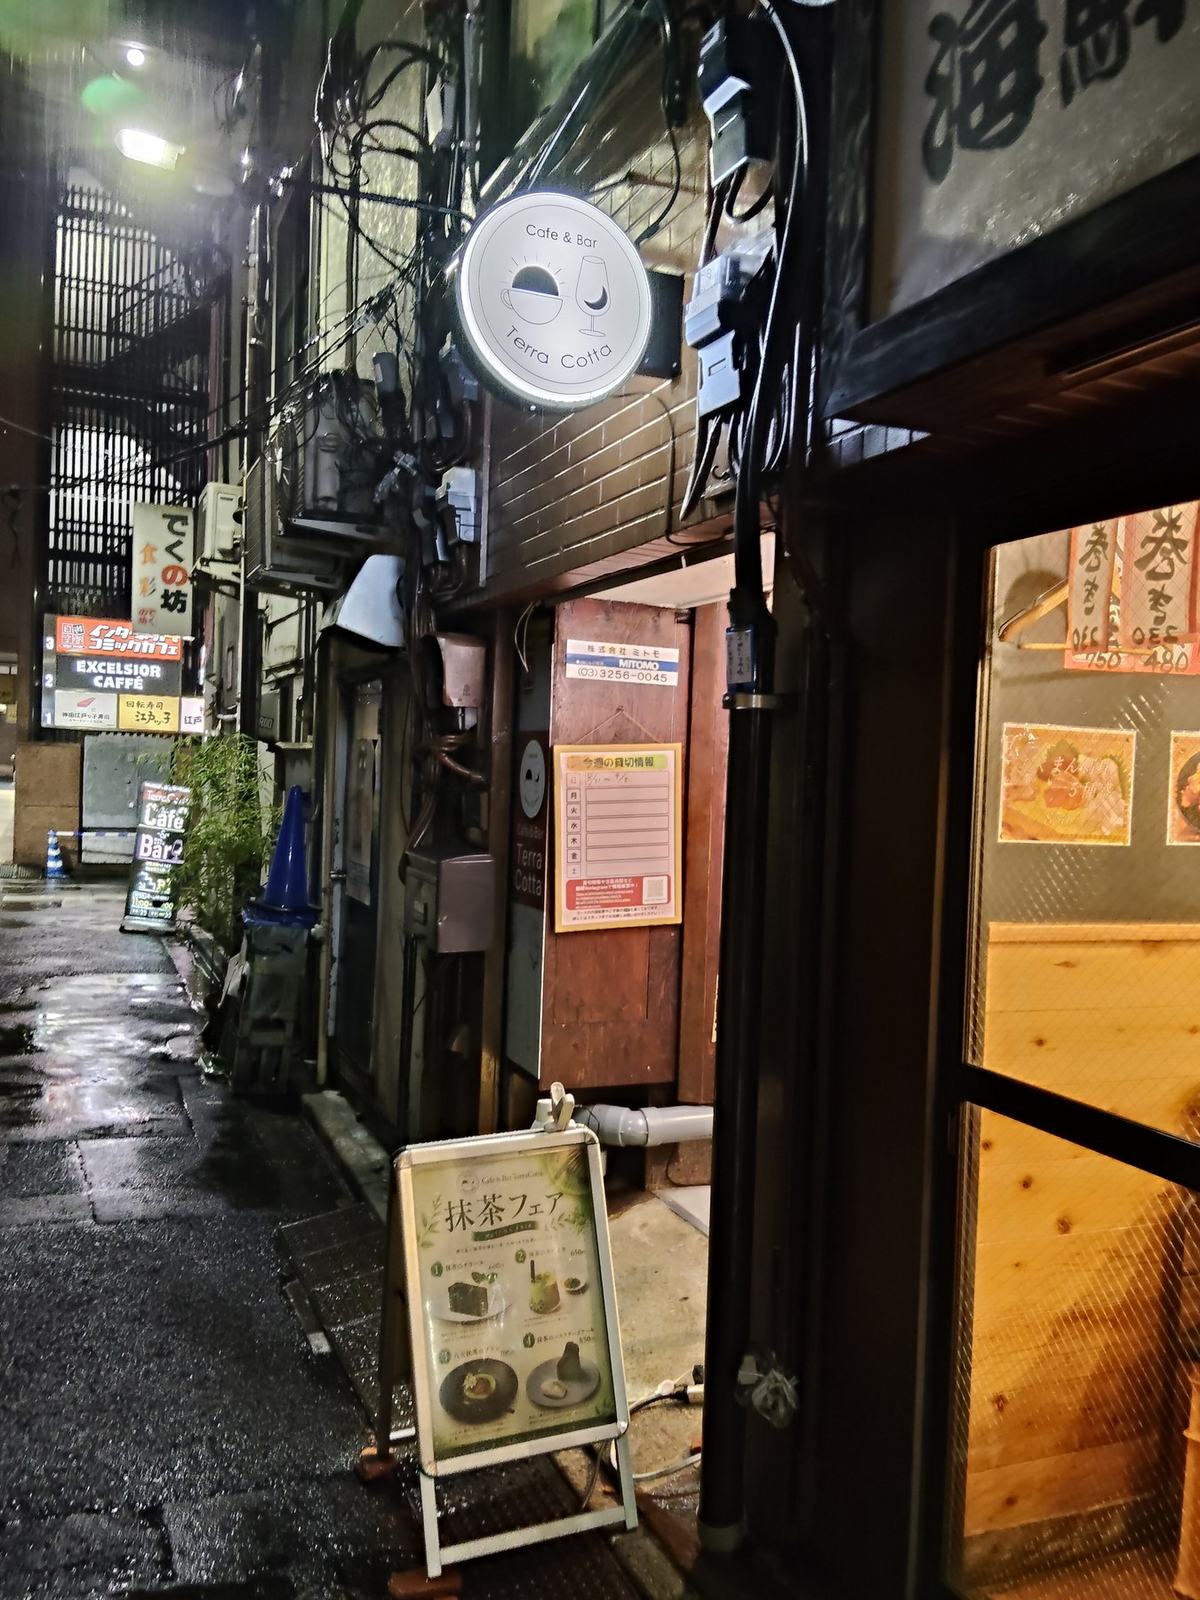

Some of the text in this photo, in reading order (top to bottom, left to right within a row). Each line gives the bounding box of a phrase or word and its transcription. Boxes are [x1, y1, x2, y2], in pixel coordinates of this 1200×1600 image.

[526, 224, 598, 248] Cafe & Bar
[505, 325, 612, 369] Terra Cotta
[160, 513, 189, 614] でくの坊
[44, 636, 55, 650] 3
[88, 636, 179, 656] コミックカフェ
[587, 645, 661, 658] 株式会社 ミトモ
[75, 660, 162, 678] EXCELSIOR
[619, 659, 659, 671] MITOMO
[44, 673, 54, 688] 2
[93, 675, 144, 690] CAFFÉ
[577, 667, 668, 683] (03)3256-0045
[125, 700, 165, 710] 回転寿司
[583, 756, 655, 769] 今週の貸切情報
[144, 802, 186, 831] Cafe
[570, 806, 578, 815] 火
[570, 821, 578, 830] 水
[140, 833, 172, 860] Bar
[570, 836, 578, 845] 木
[516, 843, 543, 870] Terra
[514, 869, 542, 897] Cotta
[445, 1192, 564, 1232] 抹茶フェア
